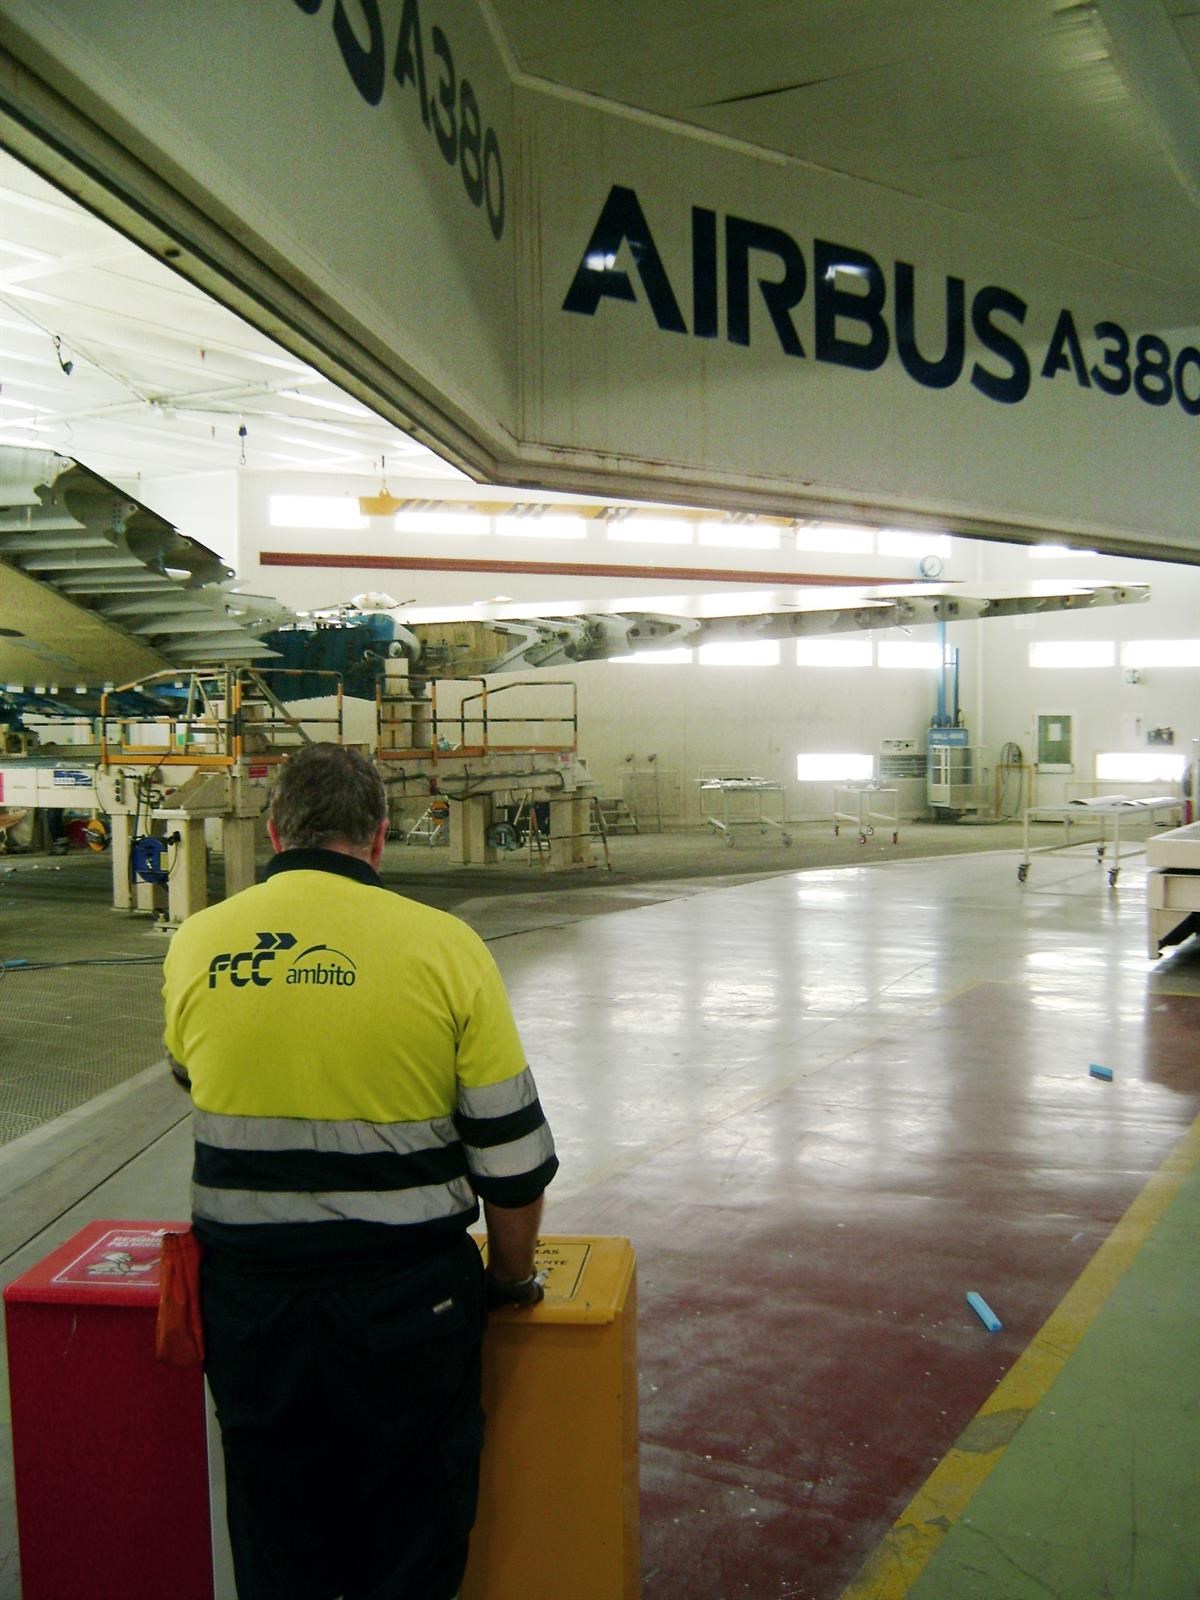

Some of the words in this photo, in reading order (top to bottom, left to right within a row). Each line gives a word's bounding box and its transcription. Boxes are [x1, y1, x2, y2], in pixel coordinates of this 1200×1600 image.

[394, 0, 504, 241] A380
[561, 184, 1031, 405] AIRBUS
[1041, 308, 1200, 416] A380
[209, 951, 275, 988] FCC
[286, 963, 355, 986] ambito
